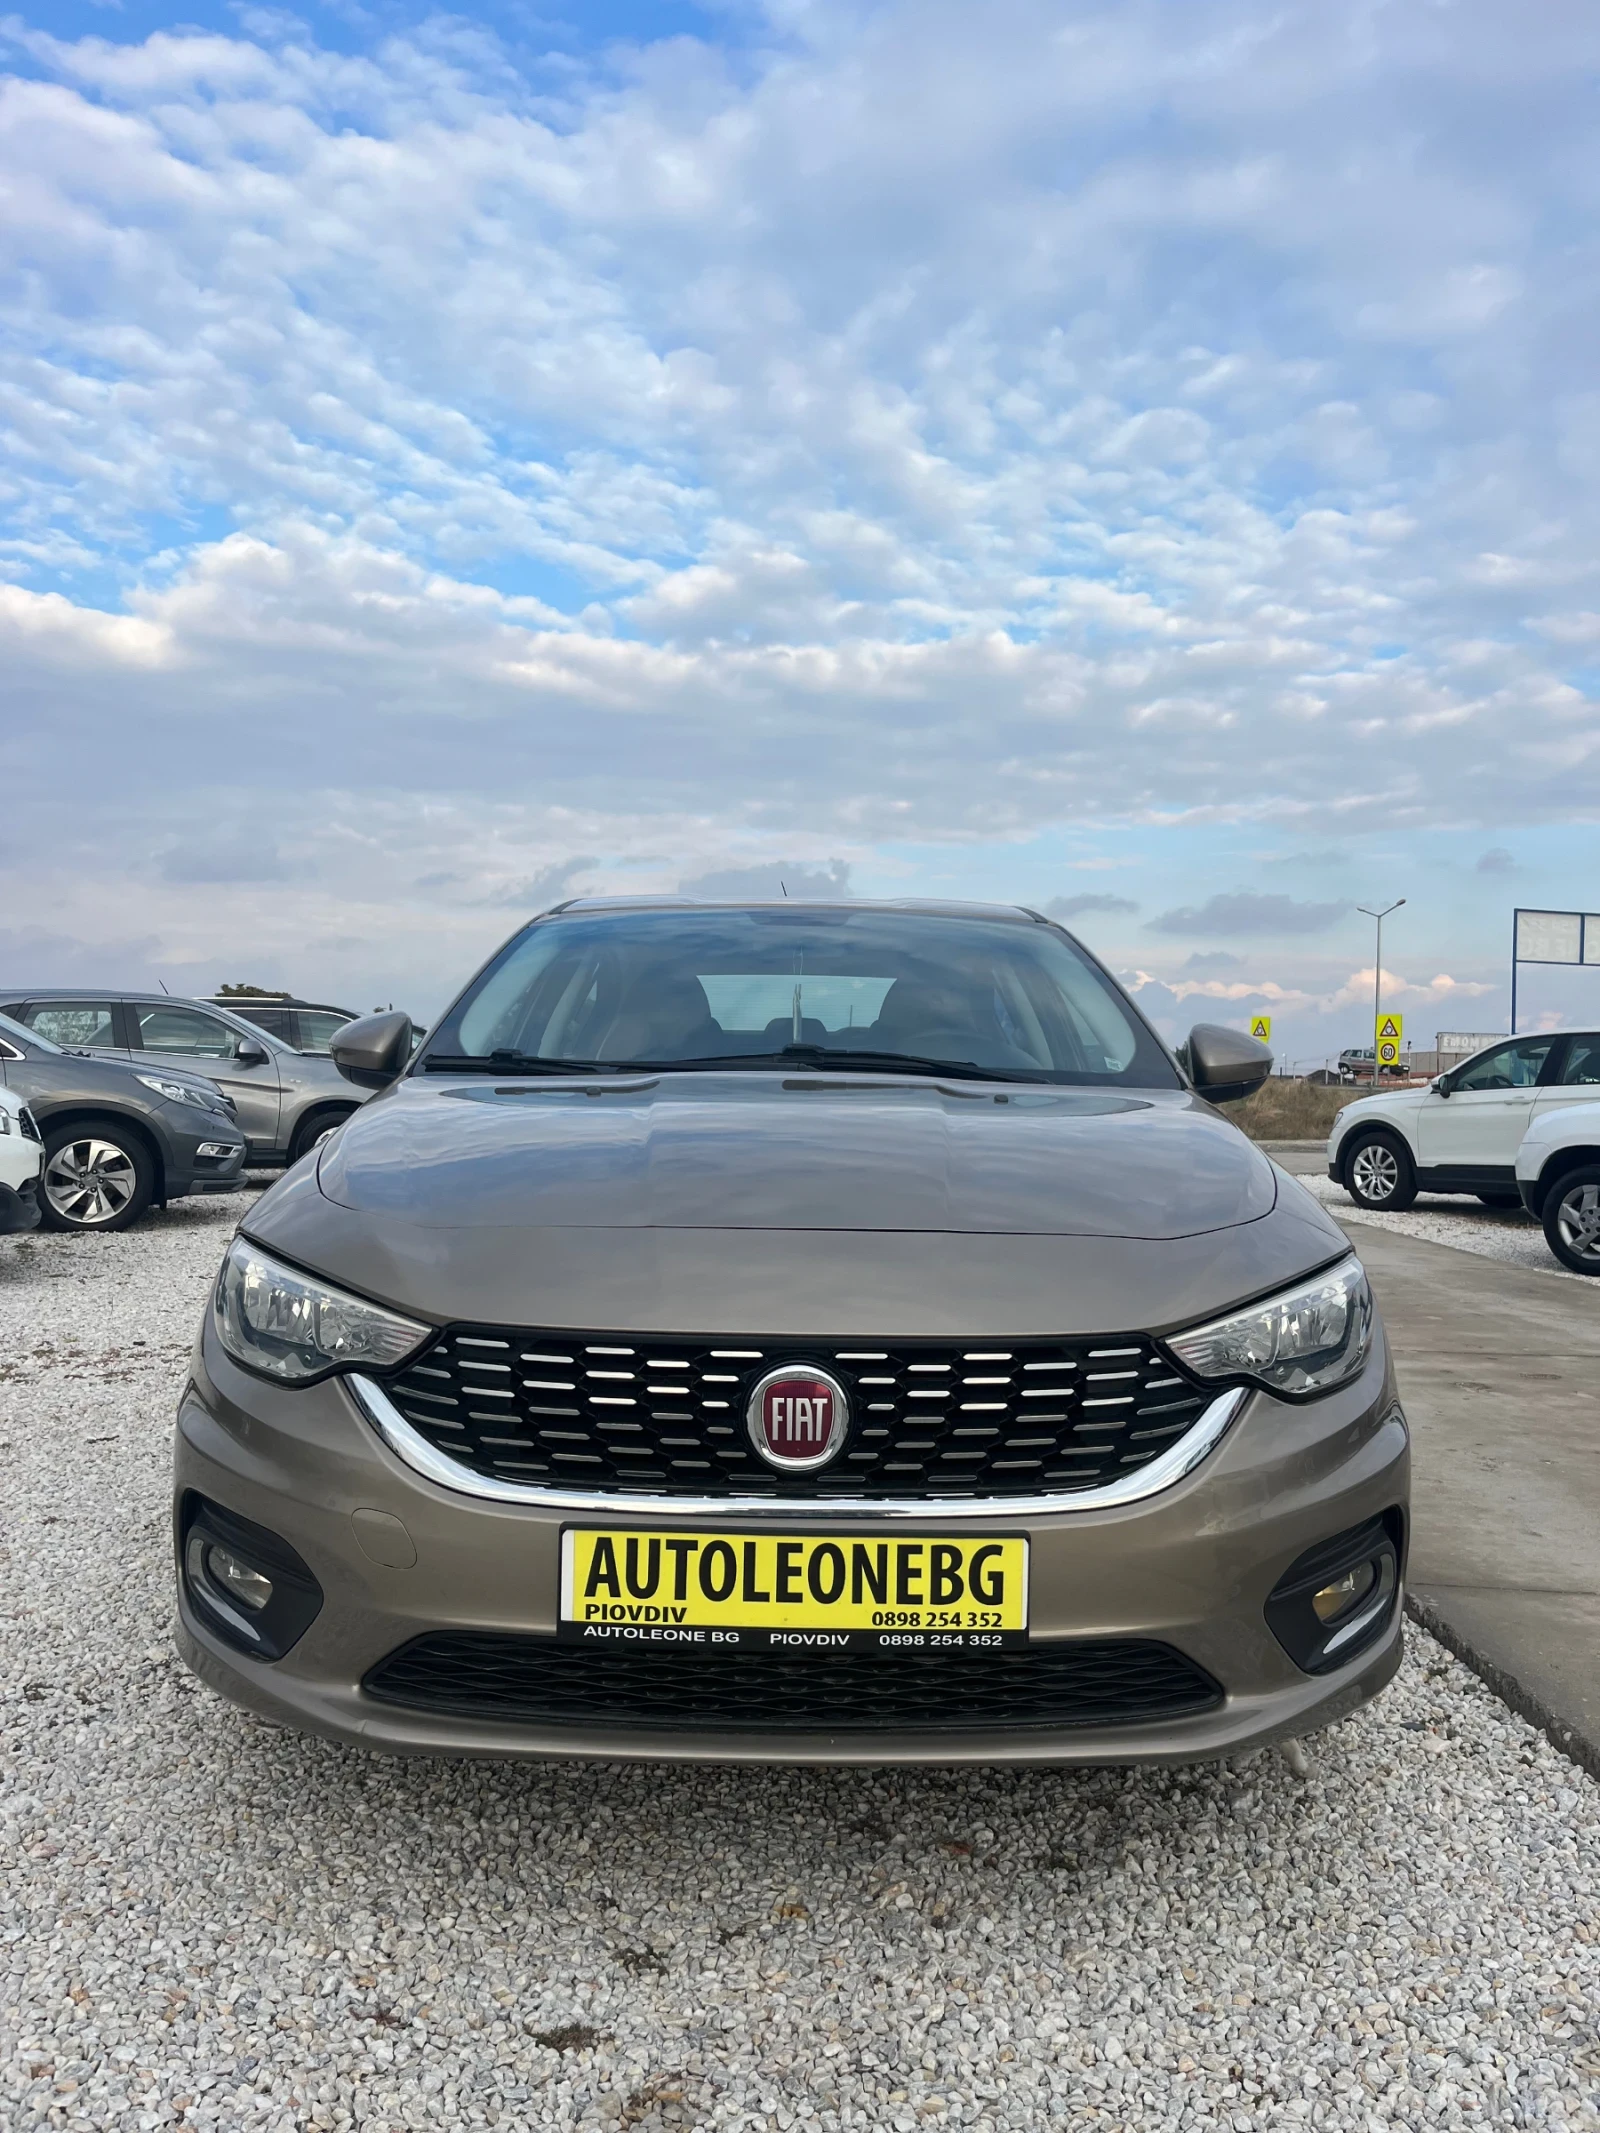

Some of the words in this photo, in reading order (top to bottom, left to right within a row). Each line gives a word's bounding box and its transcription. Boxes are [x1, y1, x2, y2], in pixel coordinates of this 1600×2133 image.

[1383, 1047, 1393, 1058] 60
[772, 1397, 828, 1441] FIAT
[584, 1536, 1004, 1606] AUTOLEONEBG
[585, 1604, 687, 1623] PIOVDIV
[872, 1612, 920, 1627] 0898
[926, 1613, 962, 1627] 254
[967, 1613, 1003, 1628] 352
[584, 1626, 706, 1642] AUTOLEONE
[711, 1631, 740, 1643] BG
[879, 1635, 925, 1646] 0898
[930, 1635, 964, 1646] 254
[969, 1635, 1003, 1646] 352
